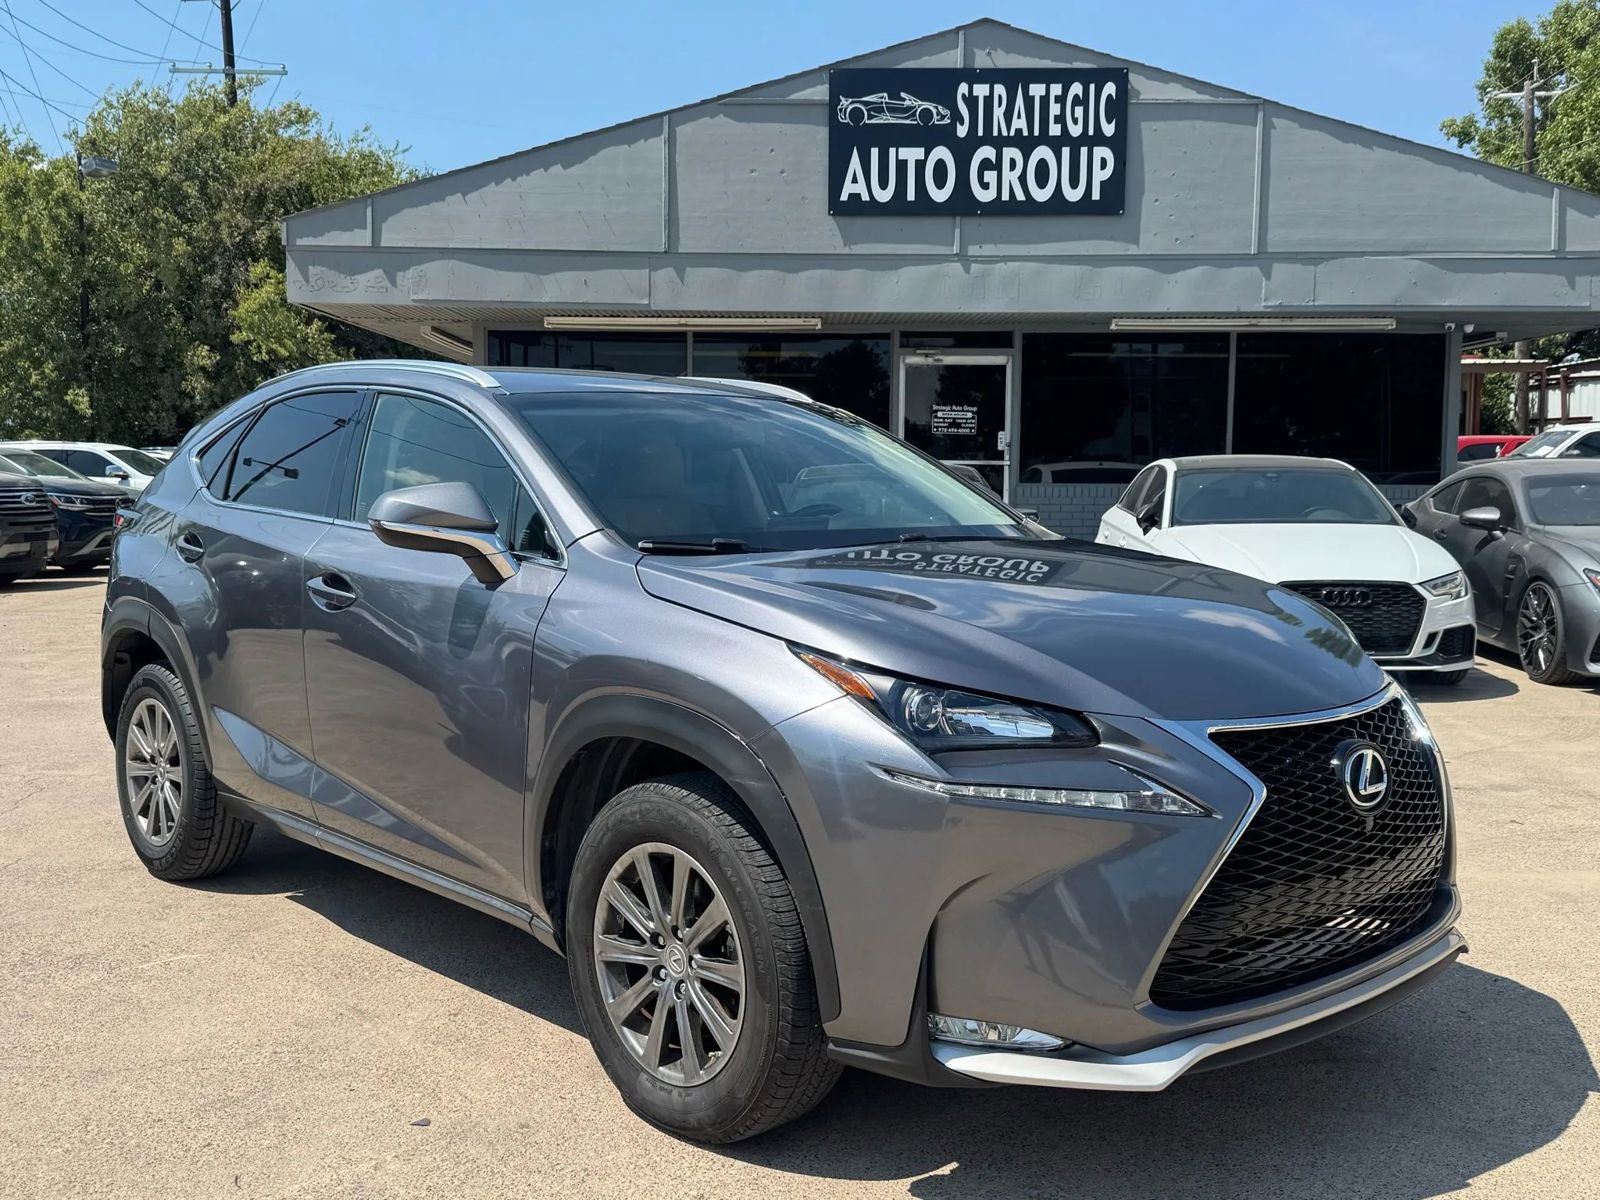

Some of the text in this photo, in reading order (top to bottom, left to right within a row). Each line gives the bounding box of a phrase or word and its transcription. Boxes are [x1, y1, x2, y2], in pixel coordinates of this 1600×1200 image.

[956, 81, 1117, 138] STRATEGIC
[839, 145, 1115, 203] AUTO GROUP
